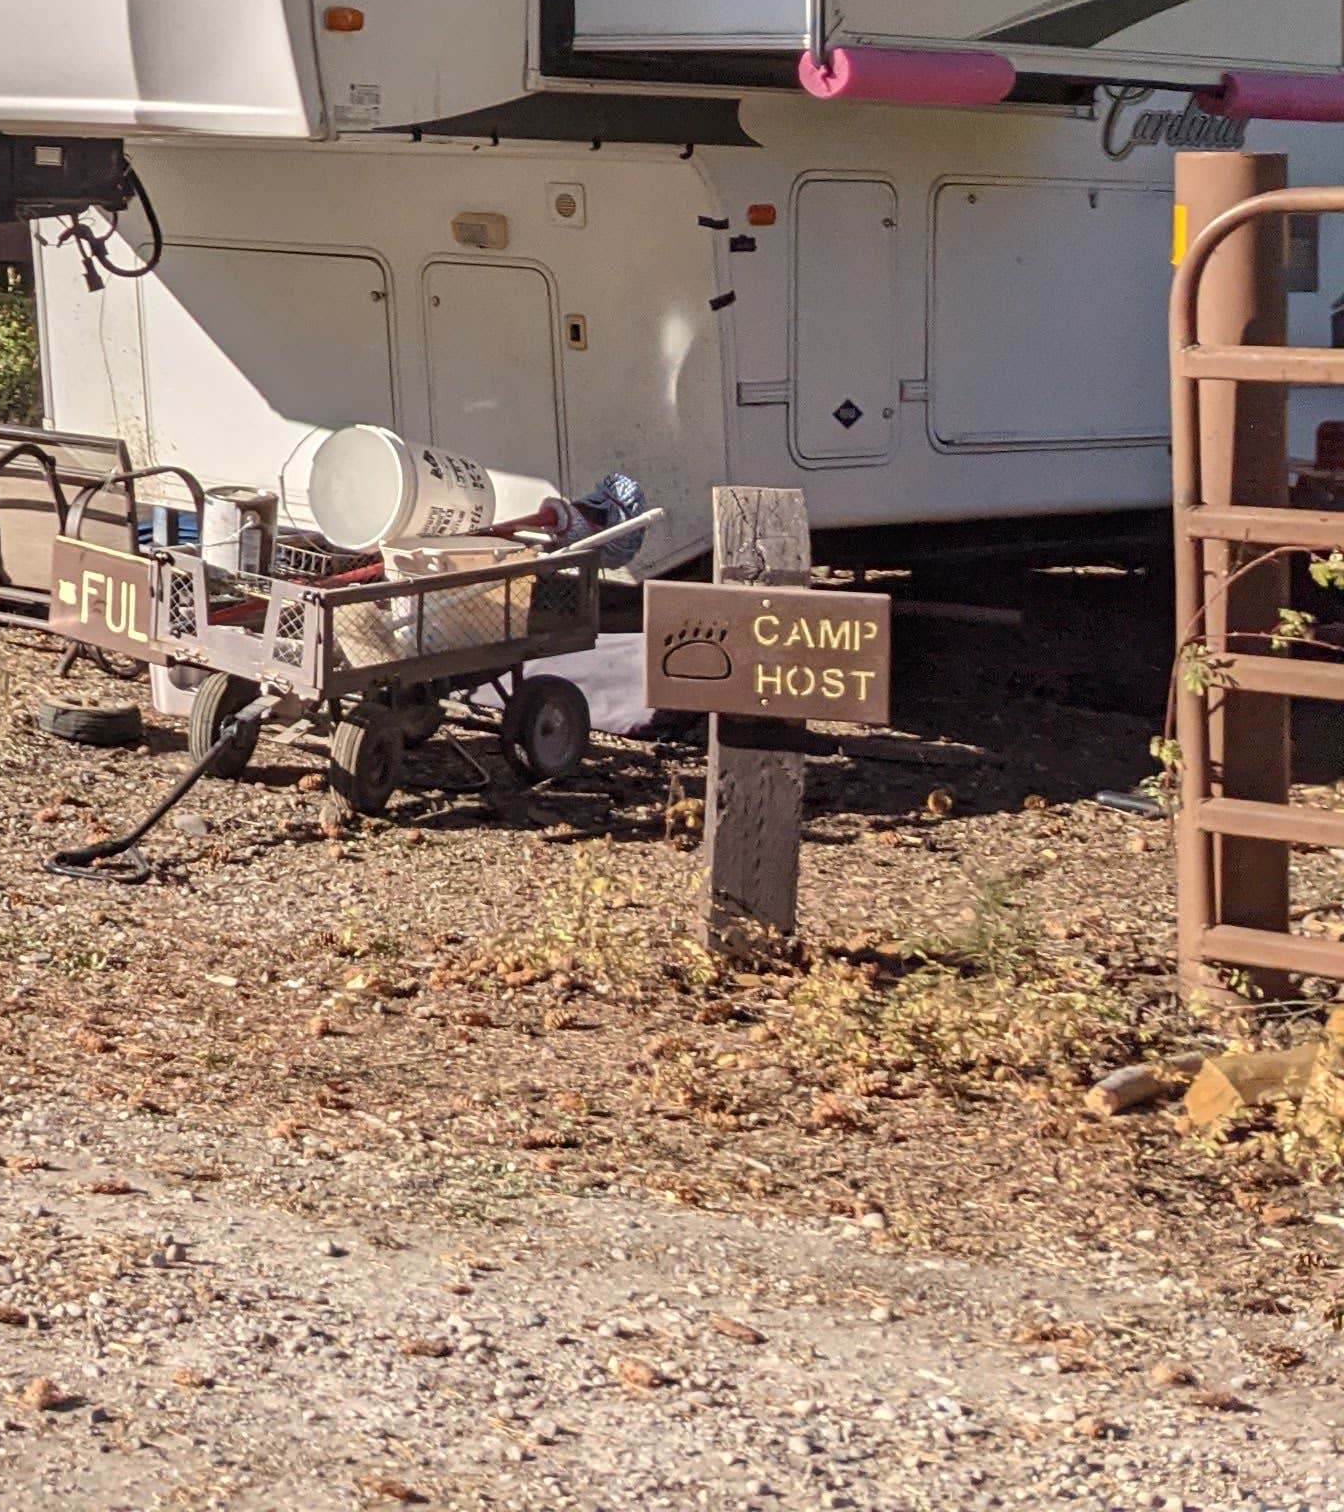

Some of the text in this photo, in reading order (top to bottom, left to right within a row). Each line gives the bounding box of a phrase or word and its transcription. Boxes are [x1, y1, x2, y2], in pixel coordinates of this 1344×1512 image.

[80, 569, 148, 643] FUL
[753, 615, 878, 652] CAMP
[756, 663, 876, 702] HOST
